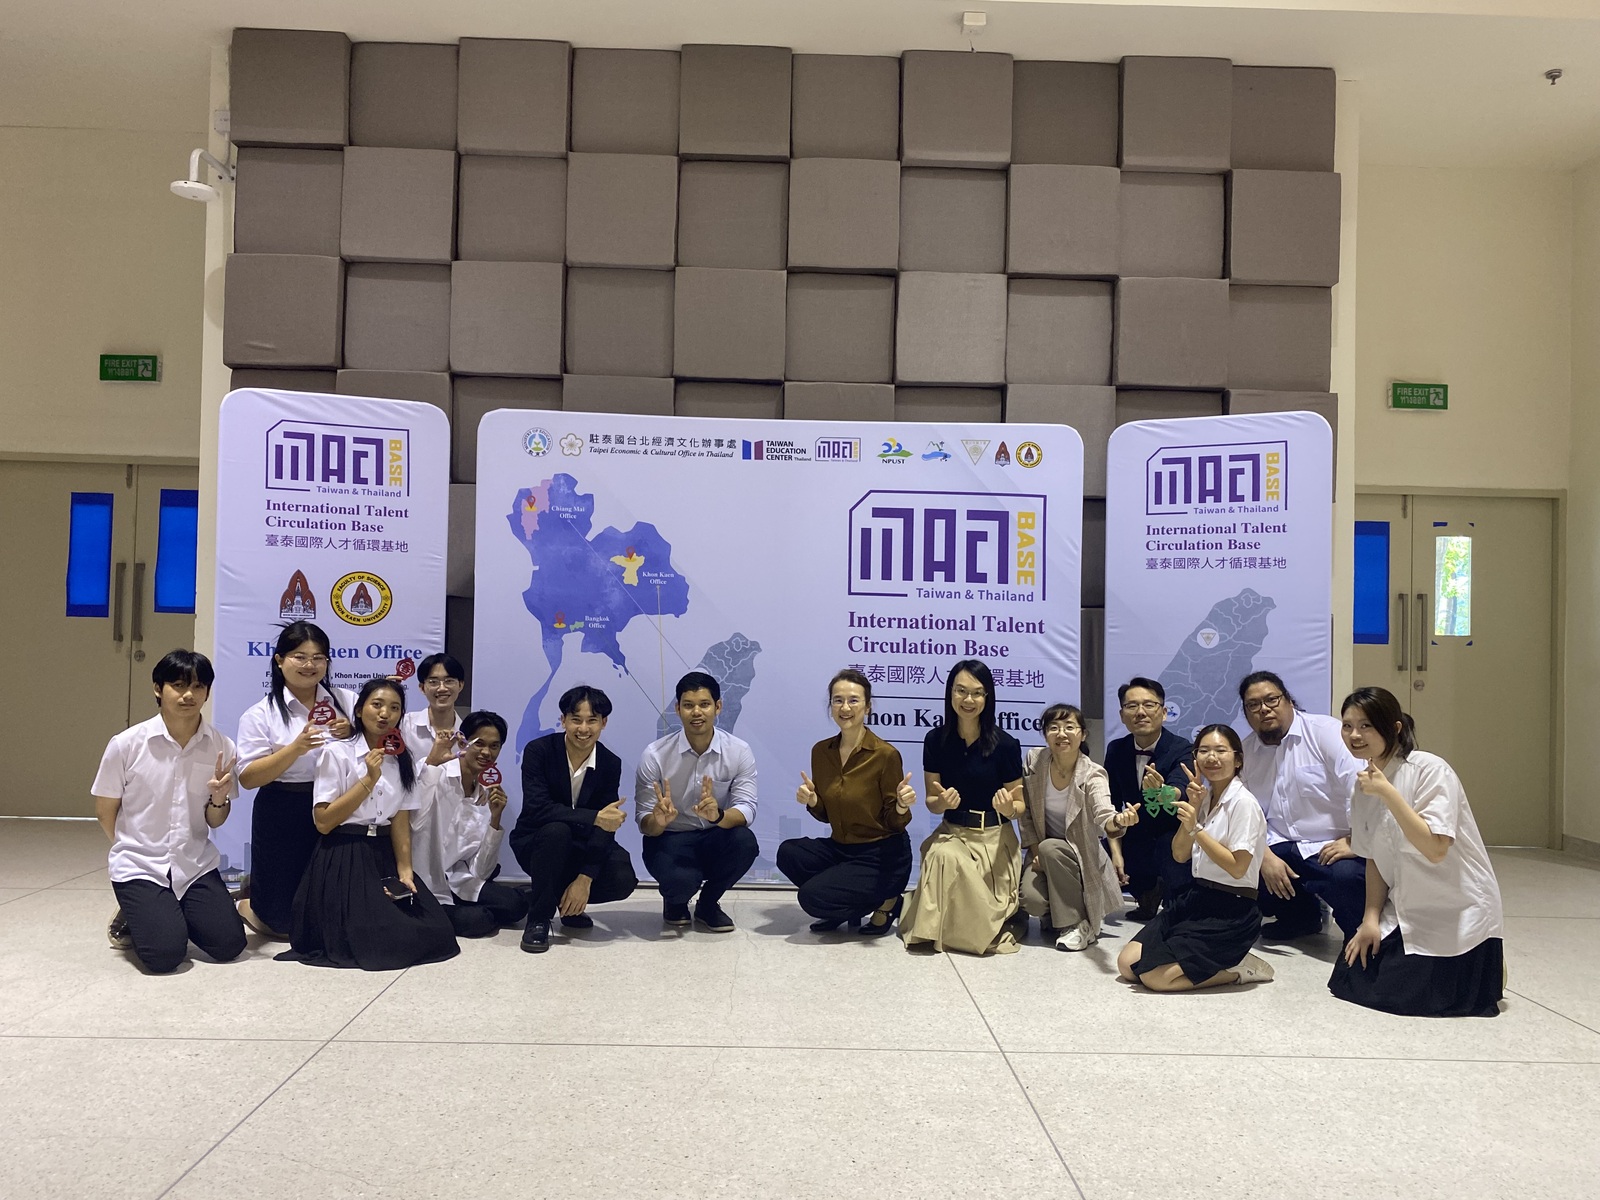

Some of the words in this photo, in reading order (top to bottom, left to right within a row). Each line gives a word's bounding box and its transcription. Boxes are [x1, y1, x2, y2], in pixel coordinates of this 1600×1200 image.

[104, 359, 119, 368] FIRE
[121, 359, 137, 368] EXIT
[1397, 387, 1412, 396] FIRE
[1413, 388, 1429, 396] EXIT
[589, 433, 737, 449] 駐泰國台北經濟文化辦事處
[589, 446, 609, 454] Taipei
[610, 447, 641, 455] Economic
[650, 449, 676, 457] Cultural
[677, 450, 697, 458] Office
[702, 450, 734, 458] Thailand
[388, 439, 402, 487] BASE
[1266, 452, 1280, 501] BASE
[316, 486, 350, 495] Taiwan
[361, 488, 402, 498] Thailand
[266, 499, 360, 516] International
[364, 504, 409, 519] Talent
[551, 505, 573, 513] Chiang
[1237, 505, 1279, 513] Thailand
[265, 515, 347, 531] Circulation
[351, 520, 384, 533] Base
[1146, 523, 1237, 536] International
[1241, 522, 1287, 534] Talent
[265, 534, 409, 553] 臺泰國際人才循環基地
[1017, 511, 1036, 586] BASE
[1146, 540, 1223, 551] Circulation
[1227, 539, 1261, 550] Base
[1146, 557, 1287, 570] 臺泰國際人才循環基地
[337, 576, 356, 592] FACULTY
[366, 576, 386, 592] SCIENCE
[916, 588, 961, 600] Taiwan
[964, 589, 974, 600] &
[978, 590, 1034, 602] Thailand
[335, 601, 345, 616] KHON
[346, 614, 361, 623] KAEN
[362, 603, 389, 623] UNIVERSITY
[584, 615, 610, 623] Bangkok
[848, 611, 976, 632] International
[982, 615, 1046, 634] Talent
[247, 641, 276, 657] Kh
[329, 647, 359, 659] aen
[366, 643, 423, 660] Office
[848, 636, 957, 656] Circulation
[964, 639, 1010, 658] Base
[353, 672, 372, 680] Kaen
[863, 711, 906, 727] hon
[913, 708, 944, 729] Ka
[998, 711, 1043, 731] ffice
